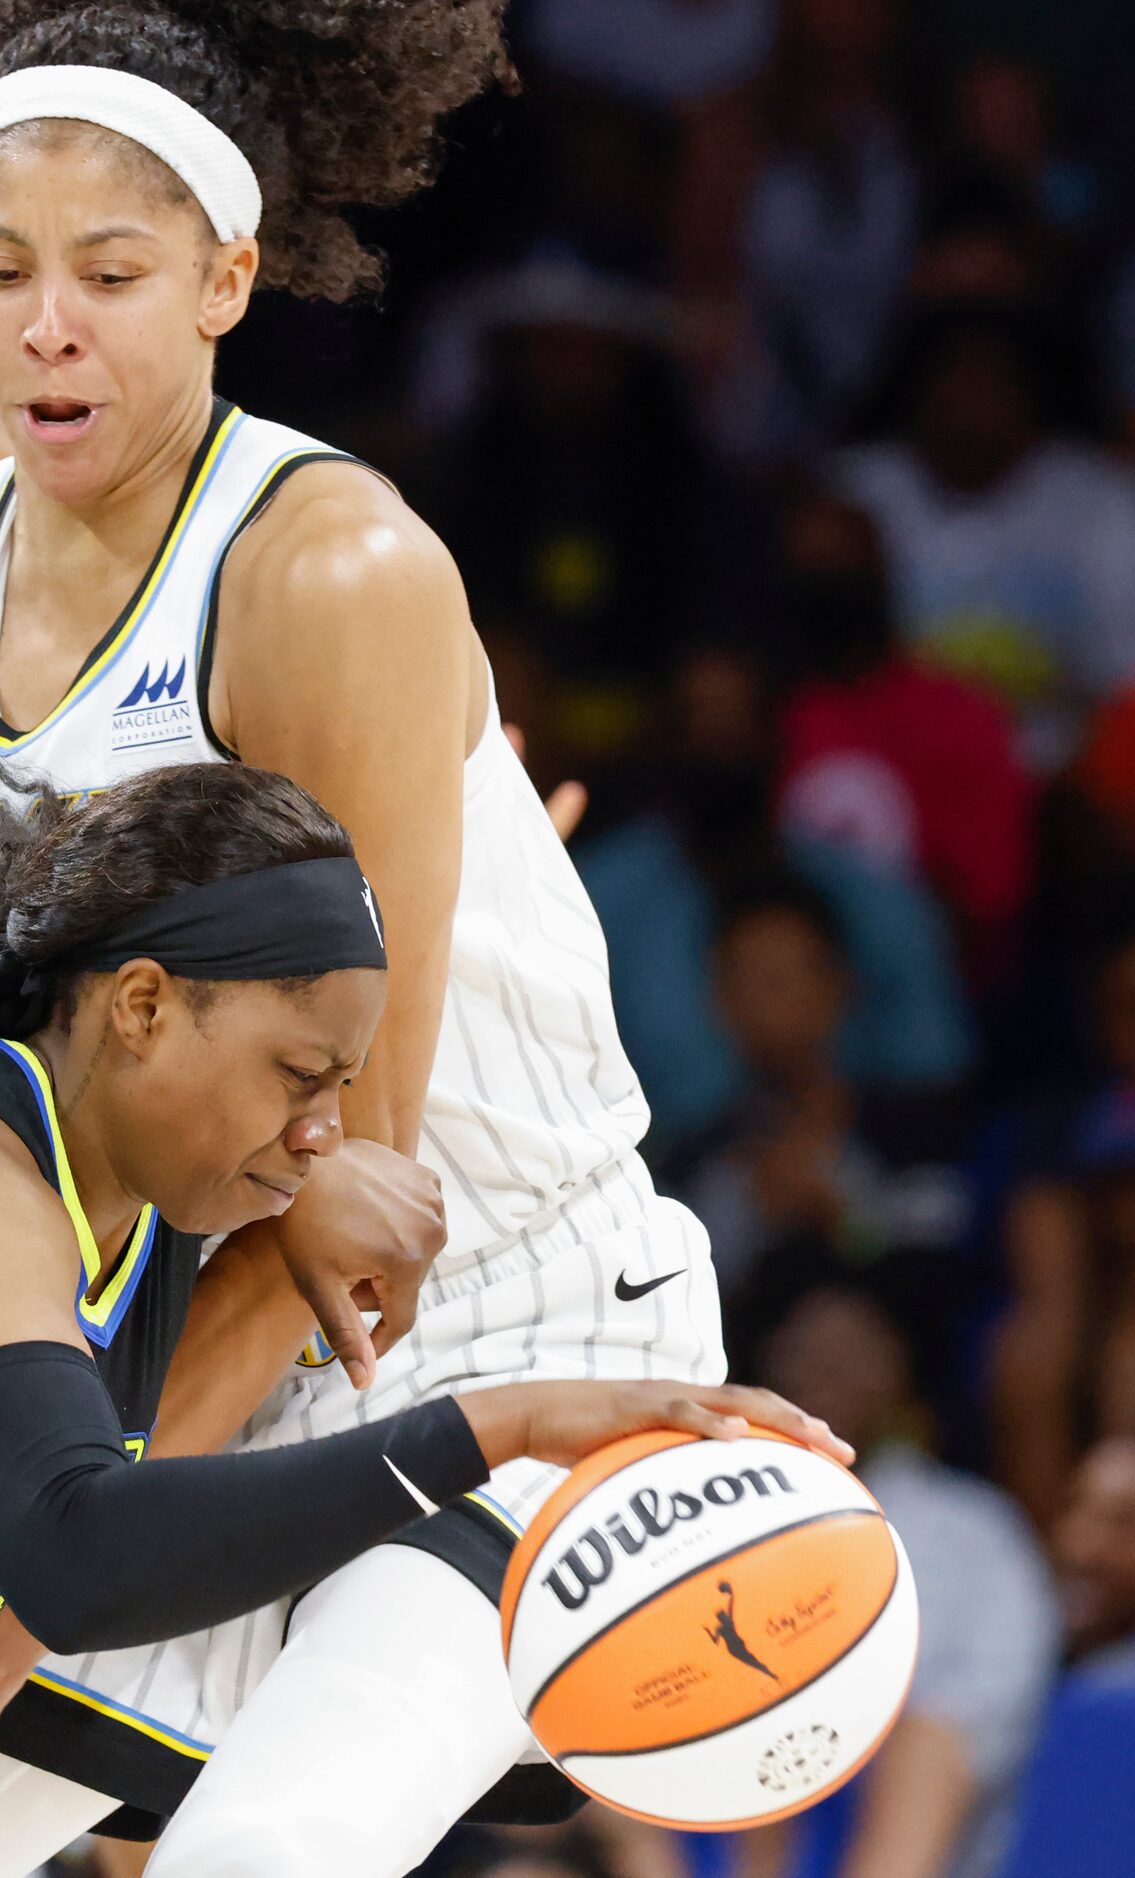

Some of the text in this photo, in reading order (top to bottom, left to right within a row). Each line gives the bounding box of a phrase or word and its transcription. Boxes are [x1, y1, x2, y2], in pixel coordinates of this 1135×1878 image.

[112, 704, 191, 732] MAGELLAN
[112, 724, 193, 745] CORPORATION
[541, 1465, 798, 1611] Wilson
